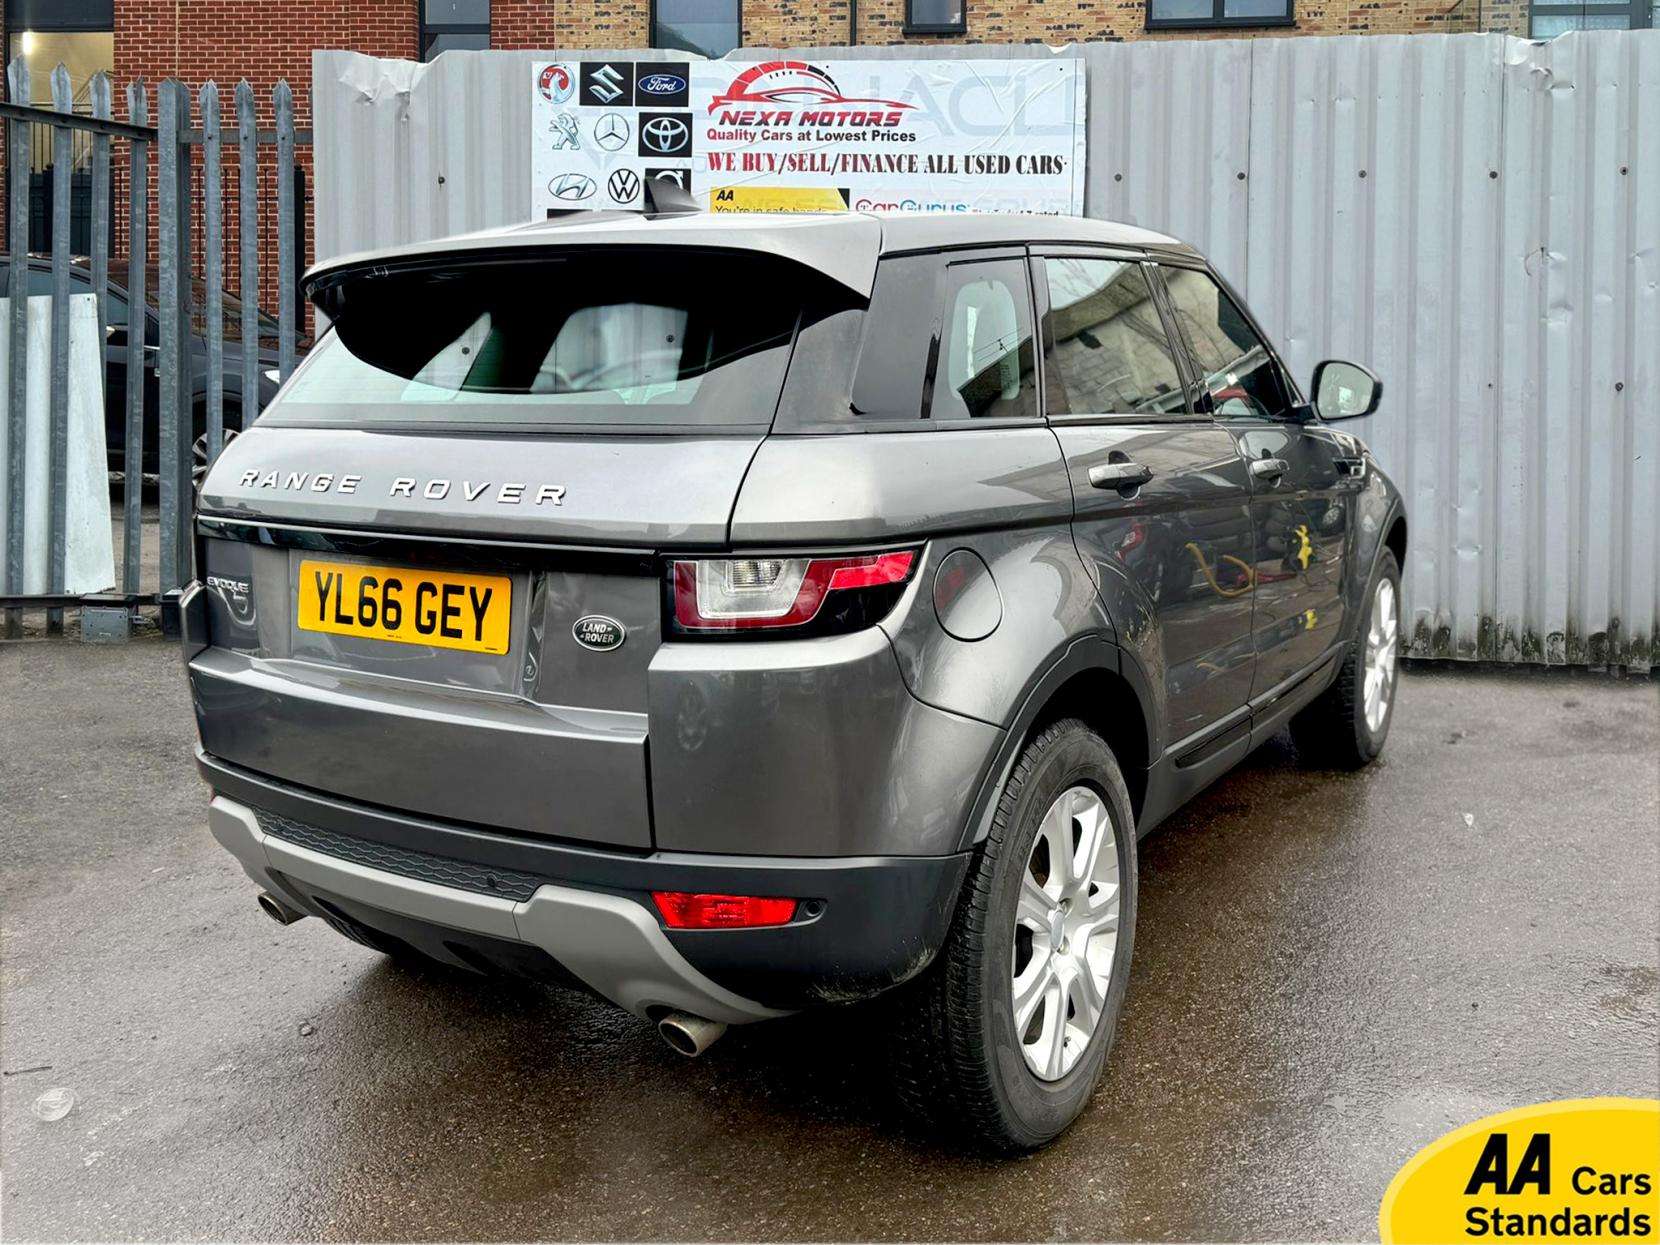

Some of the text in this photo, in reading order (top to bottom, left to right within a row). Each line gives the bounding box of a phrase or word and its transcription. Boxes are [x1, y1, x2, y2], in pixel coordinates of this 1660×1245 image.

[647, 76, 676, 91] Ford
[719, 111, 903, 127] NEXA MOTORS
[706, 129, 916, 142] Quality Cars at Lowest Prices
[707, 152, 1064, 175] WE BUY/SELL/FINANCE ALL USED CARS
[716, 189, 734, 201] AA
[239, 470, 568, 507] RANGE ROVER
[314, 570, 493, 642] YL66 GEY
